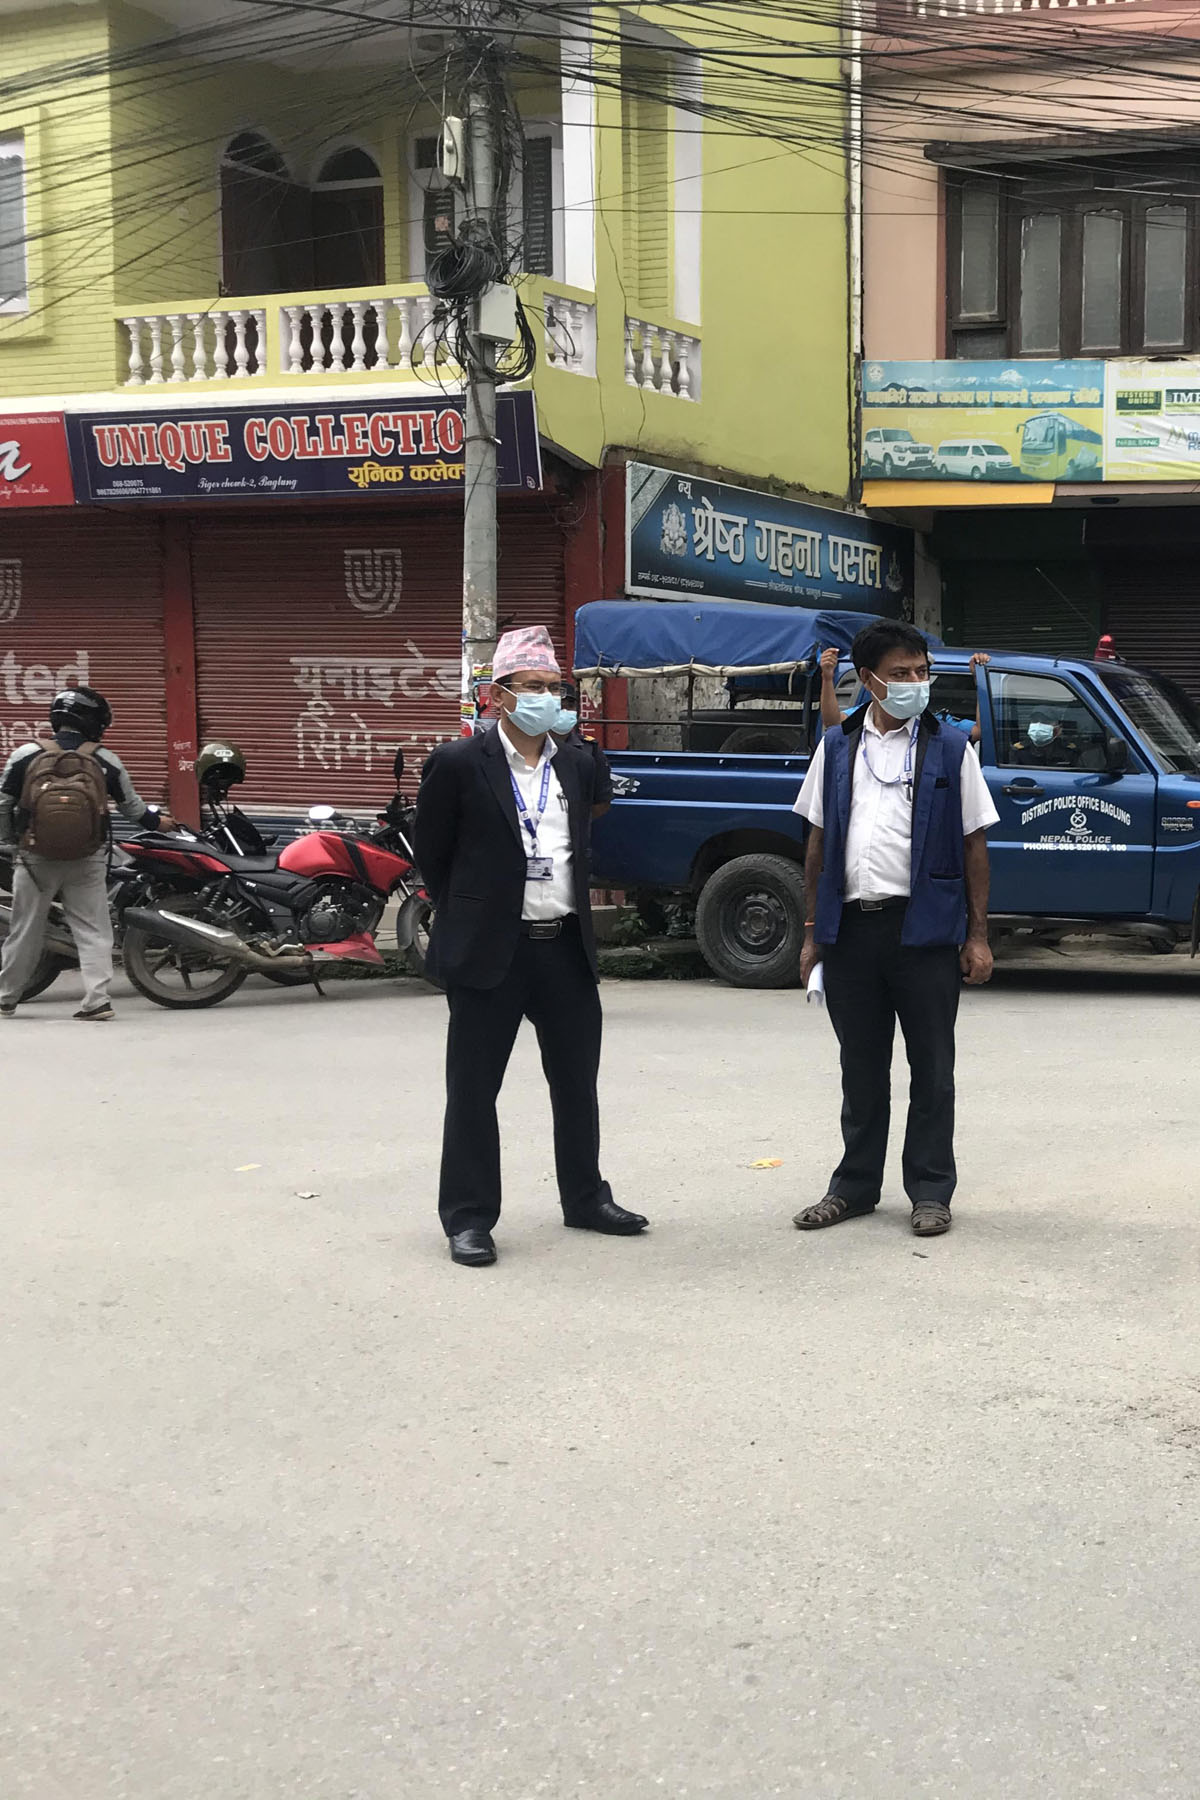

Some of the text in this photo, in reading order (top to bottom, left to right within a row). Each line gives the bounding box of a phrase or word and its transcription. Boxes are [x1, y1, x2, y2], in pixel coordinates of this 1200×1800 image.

[93, 421, 232, 473] UNIQUE
[244, 408, 467, 461] COLLECTIO
[348, 461, 404, 488] यूनिक
[678, 479, 692, 499] न्यू
[692, 497, 882, 589] श्रेष्ठ गहना पसल
[0, 650, 90, 705] ted
[1021, 795, 1131, 826] DISTRICT POLICE OFFICE BAGLUNG
[1040, 835, 1112, 844] NEPAL POLICE
